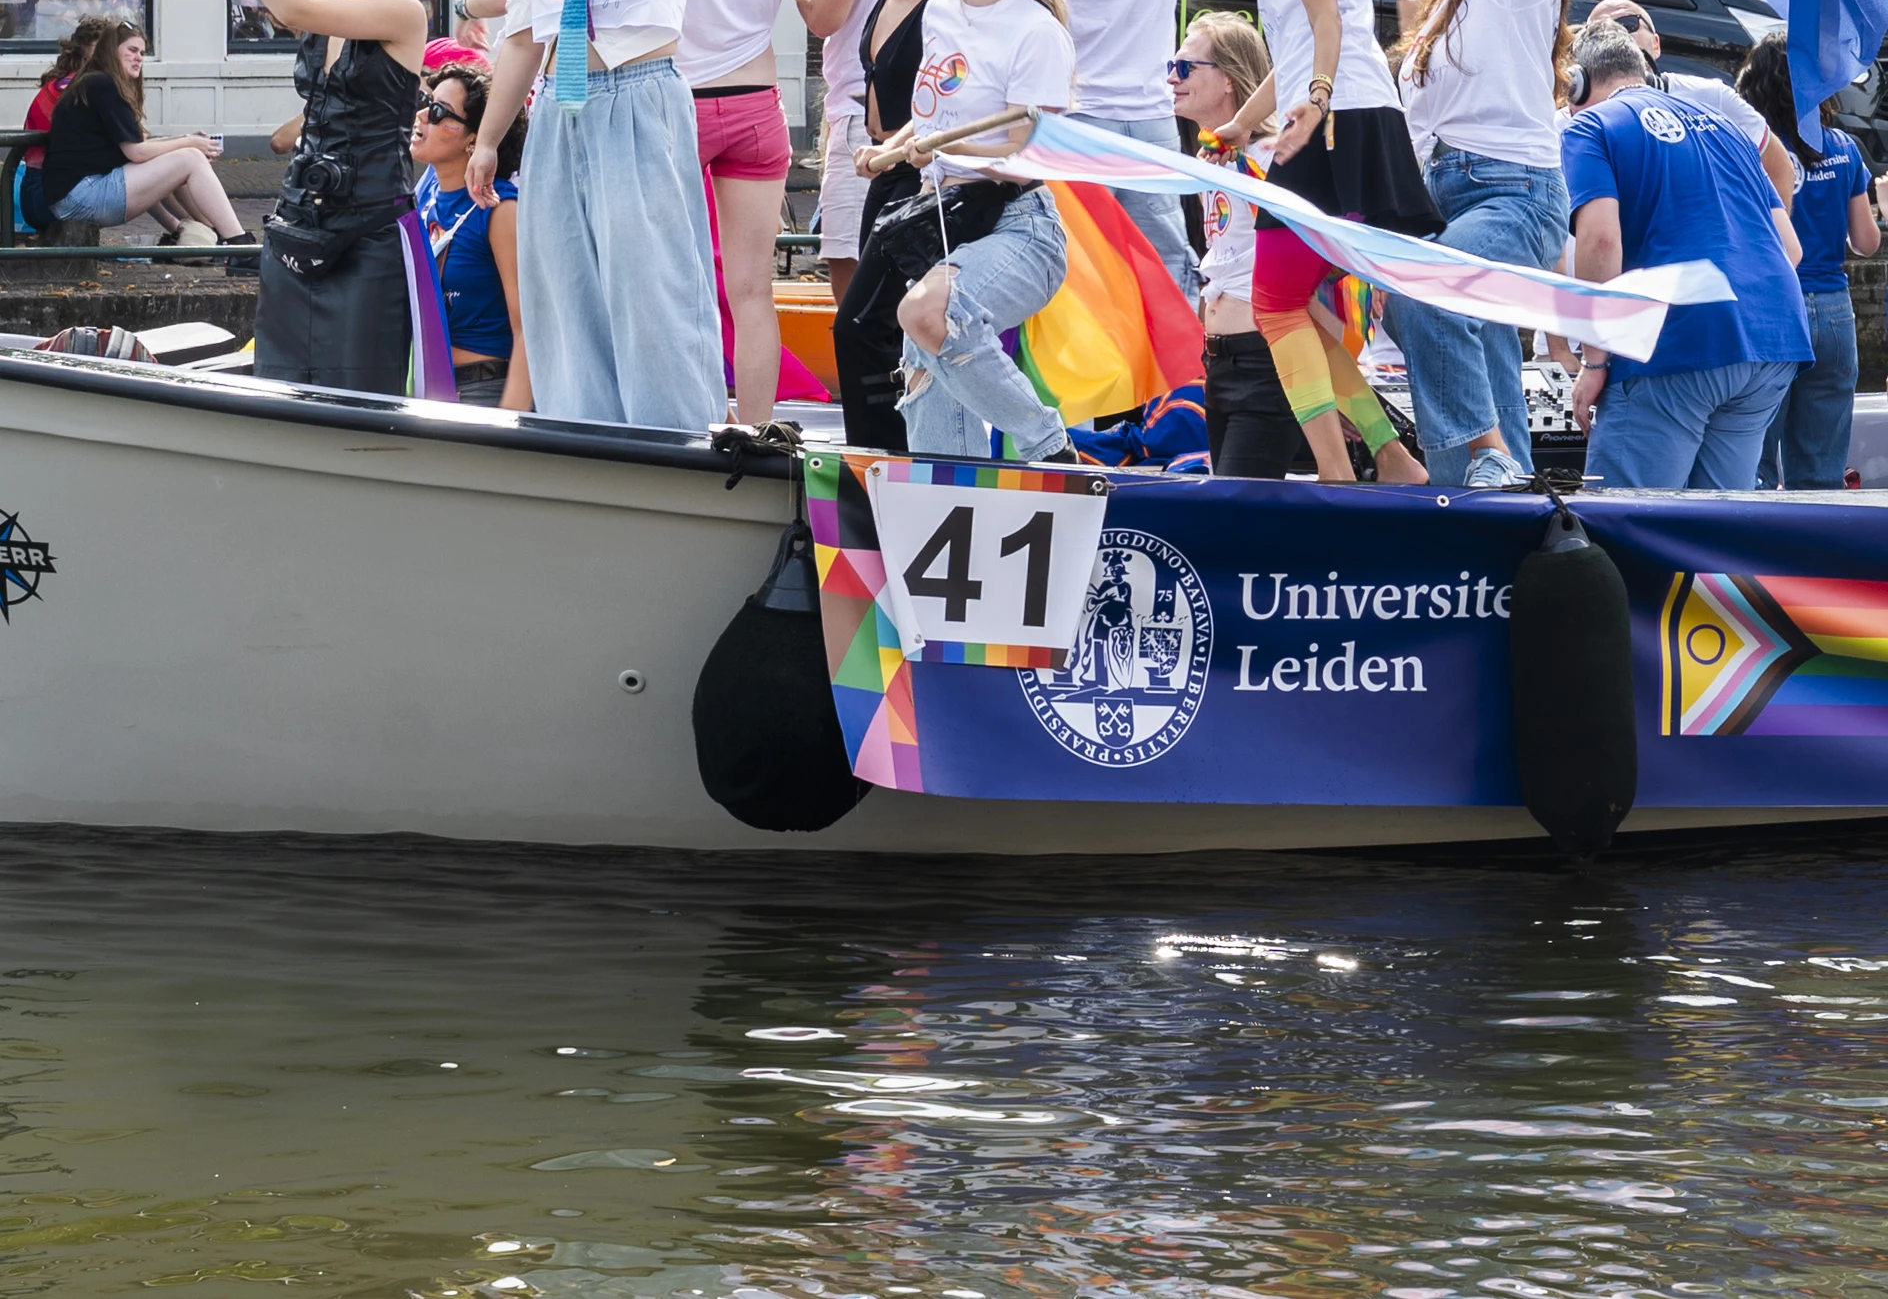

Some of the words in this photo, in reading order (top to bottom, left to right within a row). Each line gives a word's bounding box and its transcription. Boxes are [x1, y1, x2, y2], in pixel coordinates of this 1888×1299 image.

[903, 505, 1055, 628] 41
[1098, 532, 1182, 569] UGDUNO
[1157, 589, 1173, 602] 75
[1180, 573, 1210, 648] BATAVA
[1239, 570, 1511, 620] Universite
[1233, 641, 1428, 693] Leiden
[1022, 671, 1112, 762] PRAESIDIU
[1126, 654, 1207, 763] LIBERTATIS
